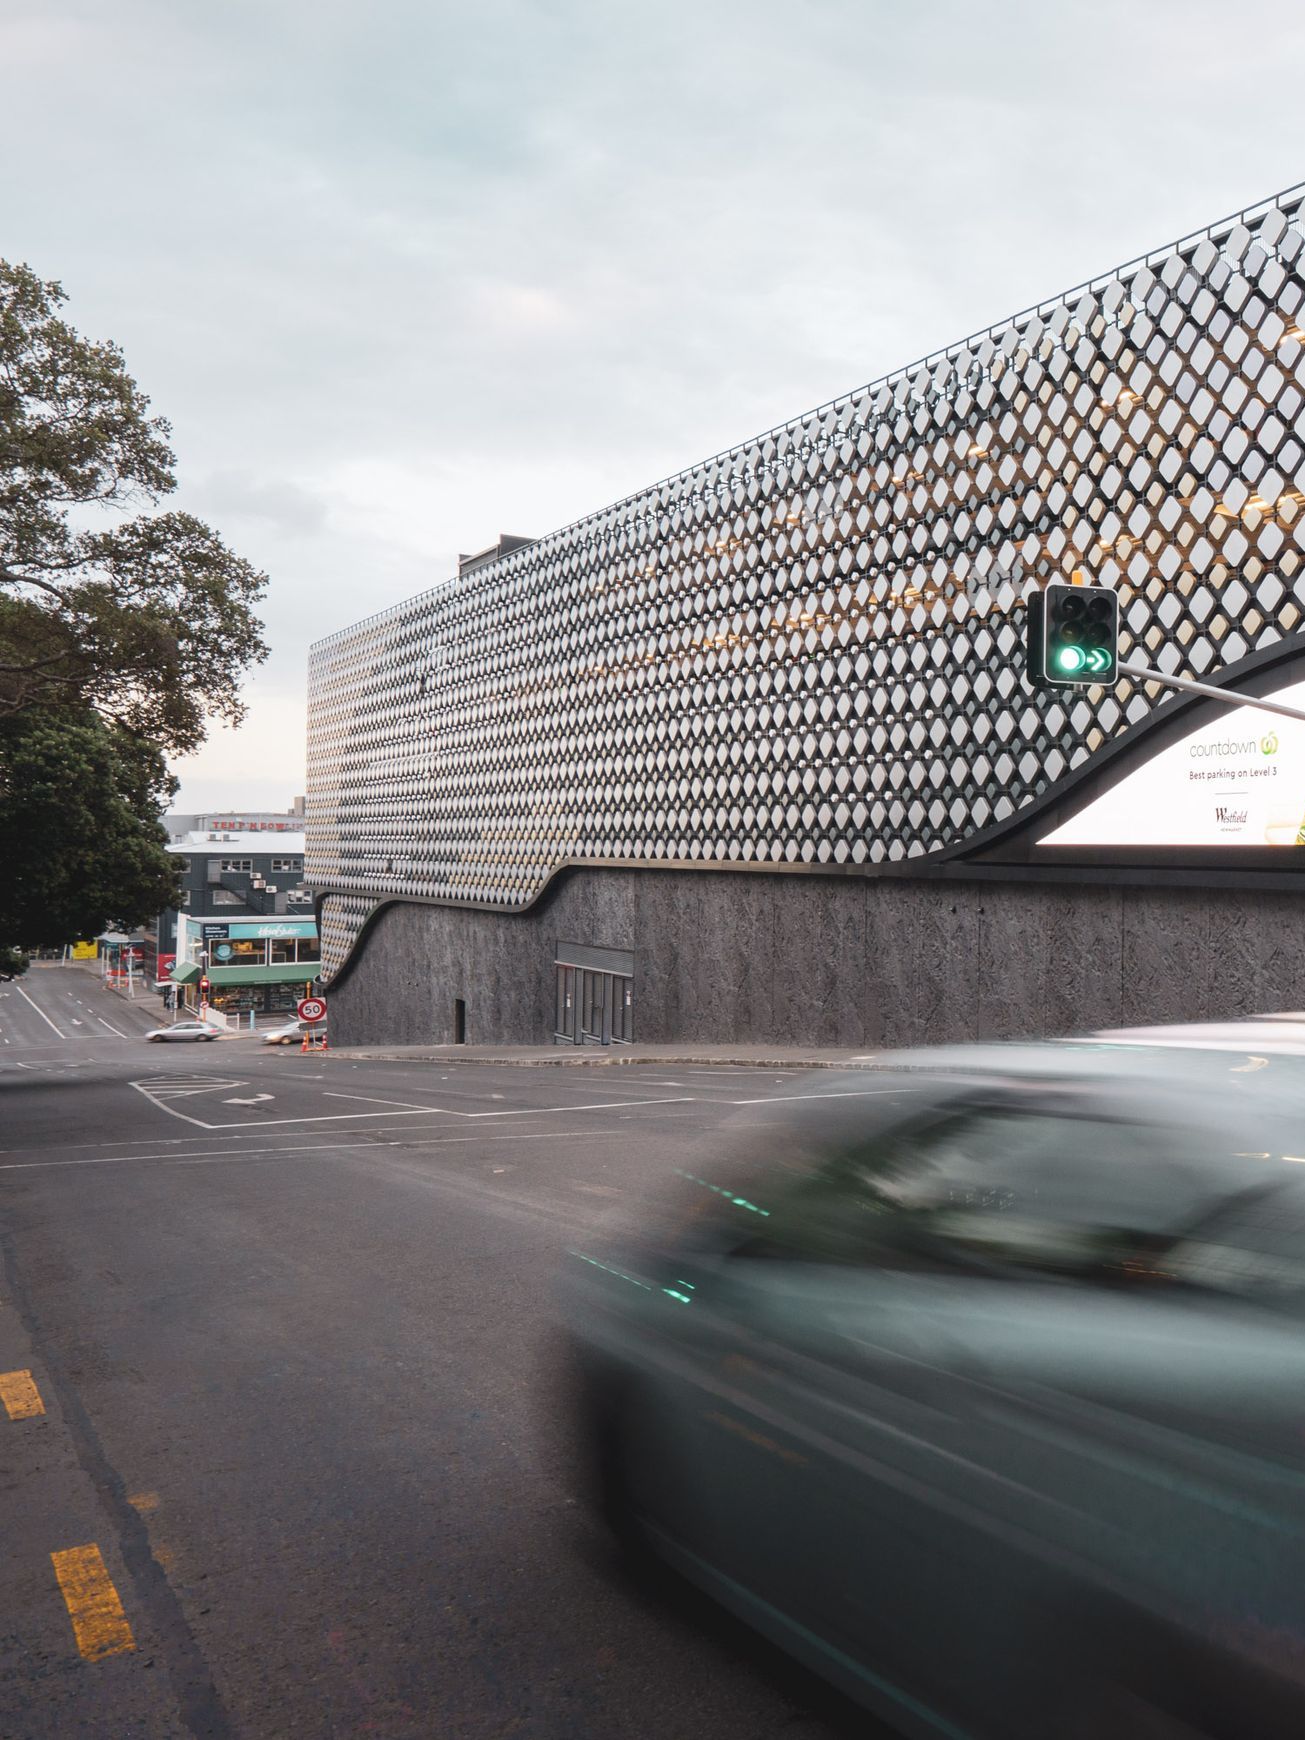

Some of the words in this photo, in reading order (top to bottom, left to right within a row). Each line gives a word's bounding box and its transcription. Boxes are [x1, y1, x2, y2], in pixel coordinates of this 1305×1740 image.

[1189, 737, 1257, 758] countdown
[1189, 771, 1205, 780] Best
[1207, 768, 1235, 782] parking
[1237, 770, 1248, 778] on
[1250, 766, 1270, 777] Level
[1272, 766, 1278, 776] 3
[1215, 807, 1248, 824] Westfield
[213, 821, 235, 829] TEN
[238, 822, 257, 830] PN
[305, 1004, 320, 1015] 50
